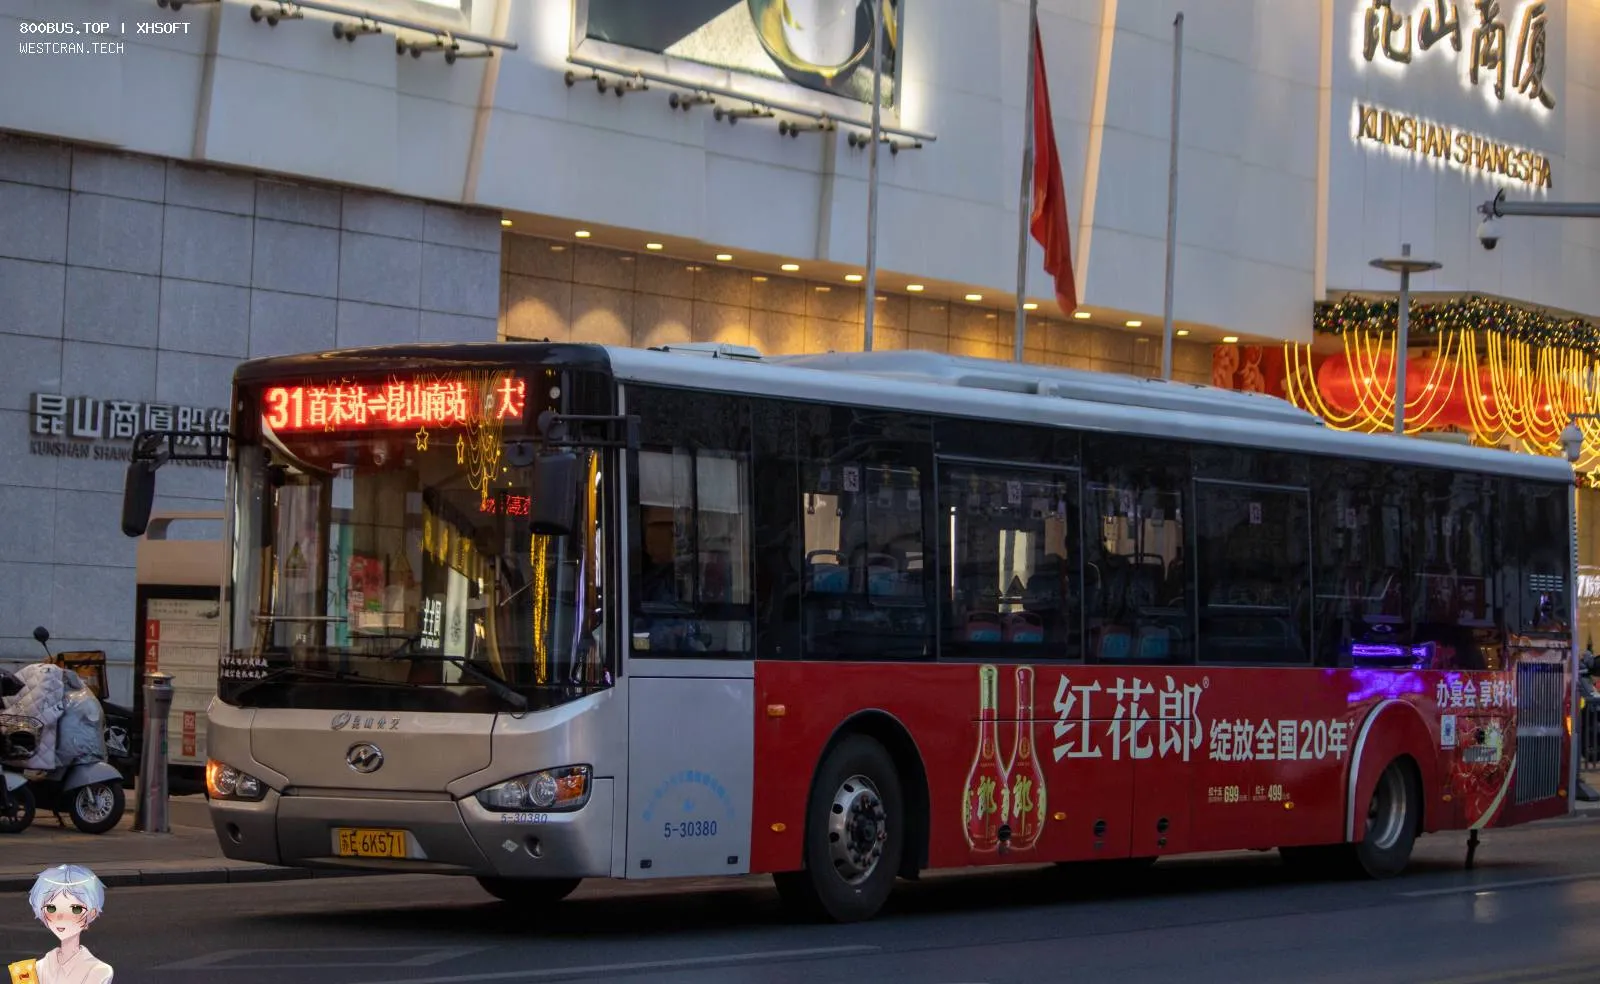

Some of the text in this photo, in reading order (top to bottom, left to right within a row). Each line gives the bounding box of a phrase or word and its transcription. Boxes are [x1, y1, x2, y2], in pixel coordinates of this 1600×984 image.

[1357, 103, 1553, 188] KUNSHAN SHANGSHA
[268, 387, 303, 428] 31
[30, 440, 89, 460] KUNSHAN
[1436, 679, 1477, 708] 办宴会
[1223, 784, 1239, 803] 699
[1267, 783, 1283, 802] 499
[501, 813, 548, 824] 5-30380
[663, 820, 717, 838] 5-30380
